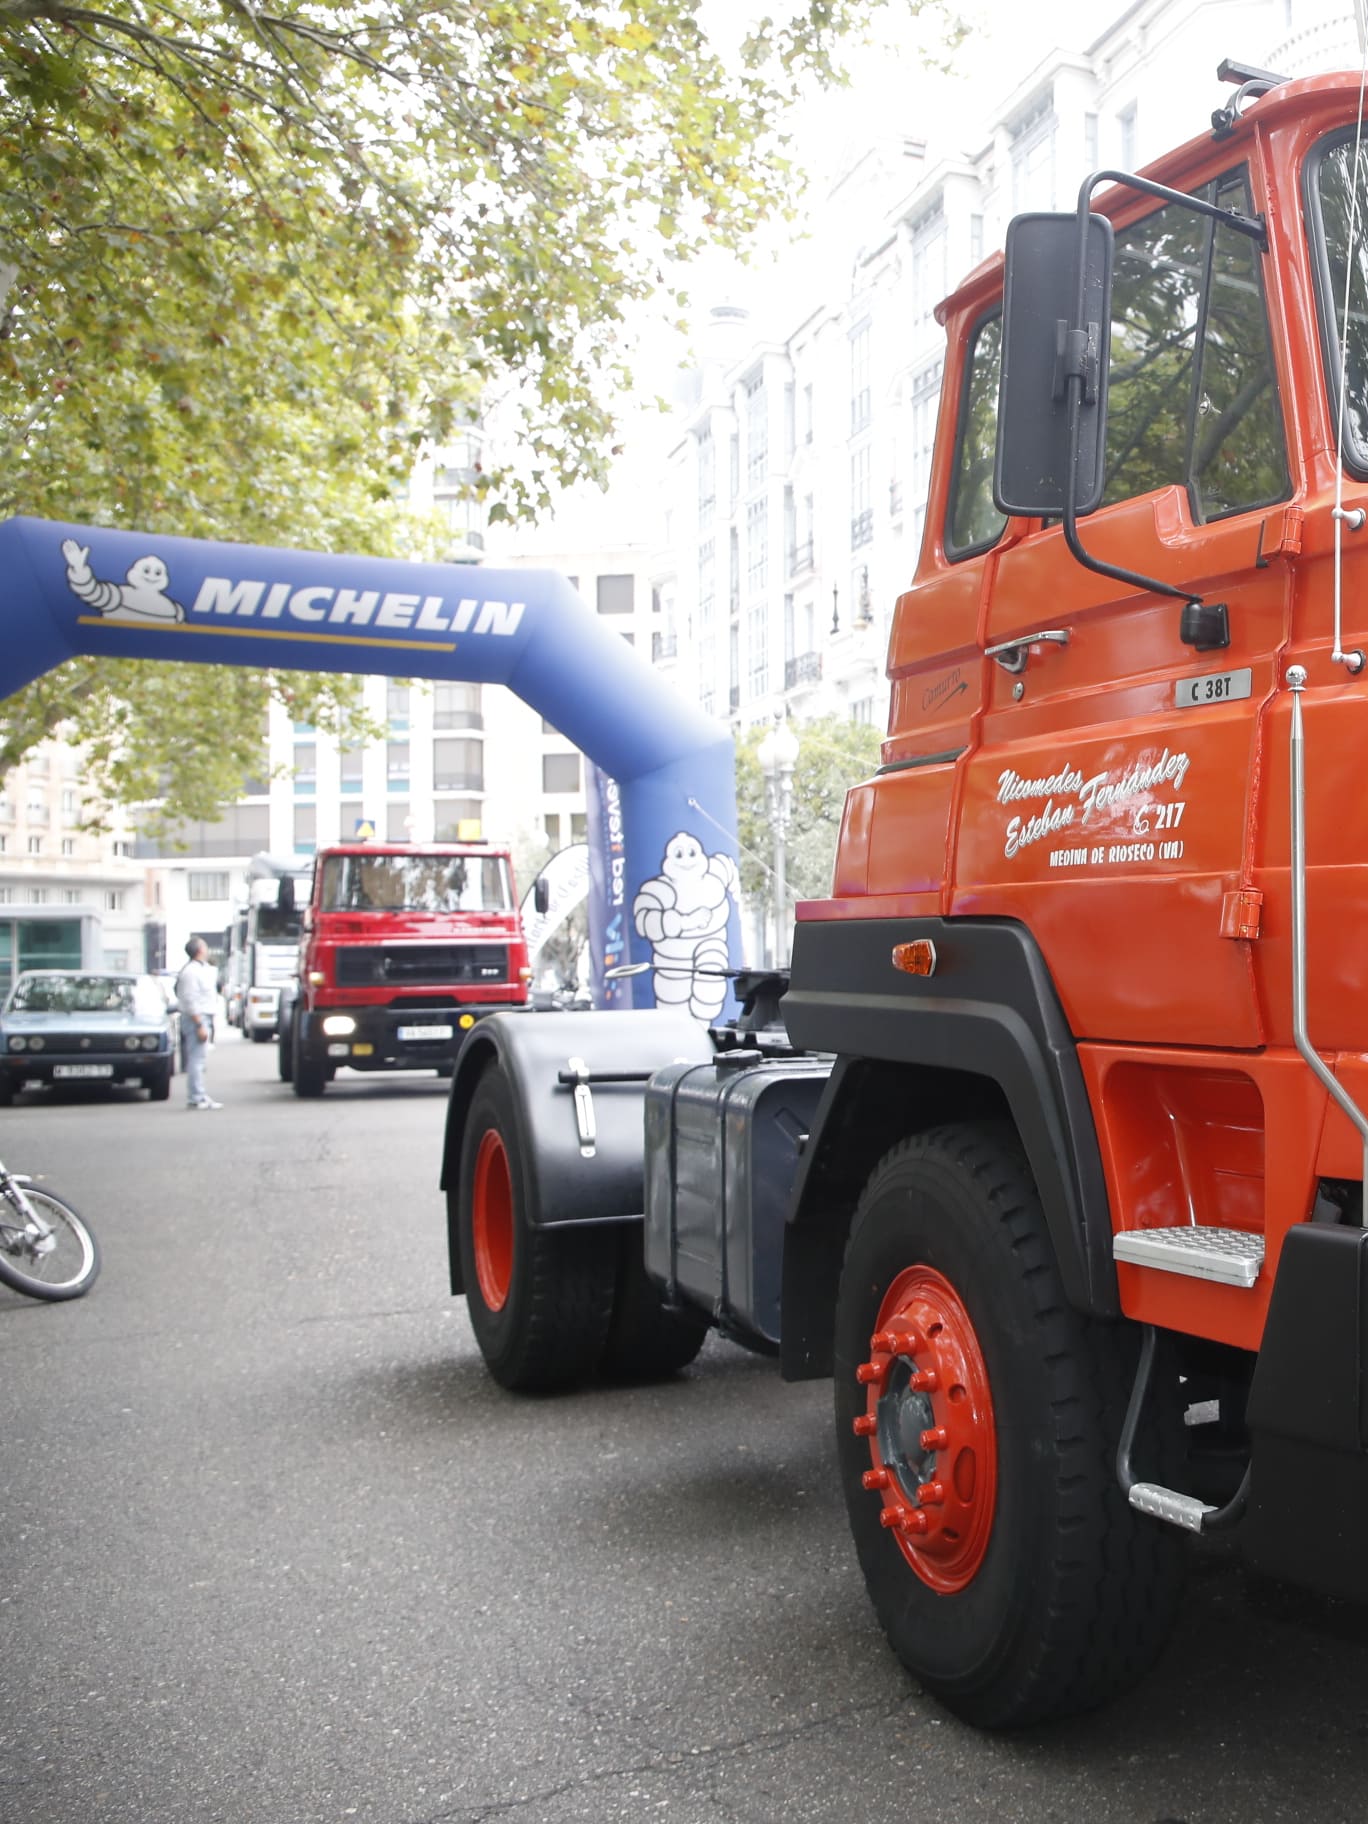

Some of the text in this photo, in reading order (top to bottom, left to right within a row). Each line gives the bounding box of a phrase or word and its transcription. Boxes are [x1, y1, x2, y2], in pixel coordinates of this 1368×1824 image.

[193, 577, 526, 636] MICHELIN
[1191, 677, 1232, 701] C 38T
[997, 763, 1084, 804] Nicomedes
[1004, 748, 1190, 859] Esteban Fernández
[1154, 801, 1186, 829] 217
[1050, 840, 1184, 867] MEDINA DE RIOSECO (VA)
